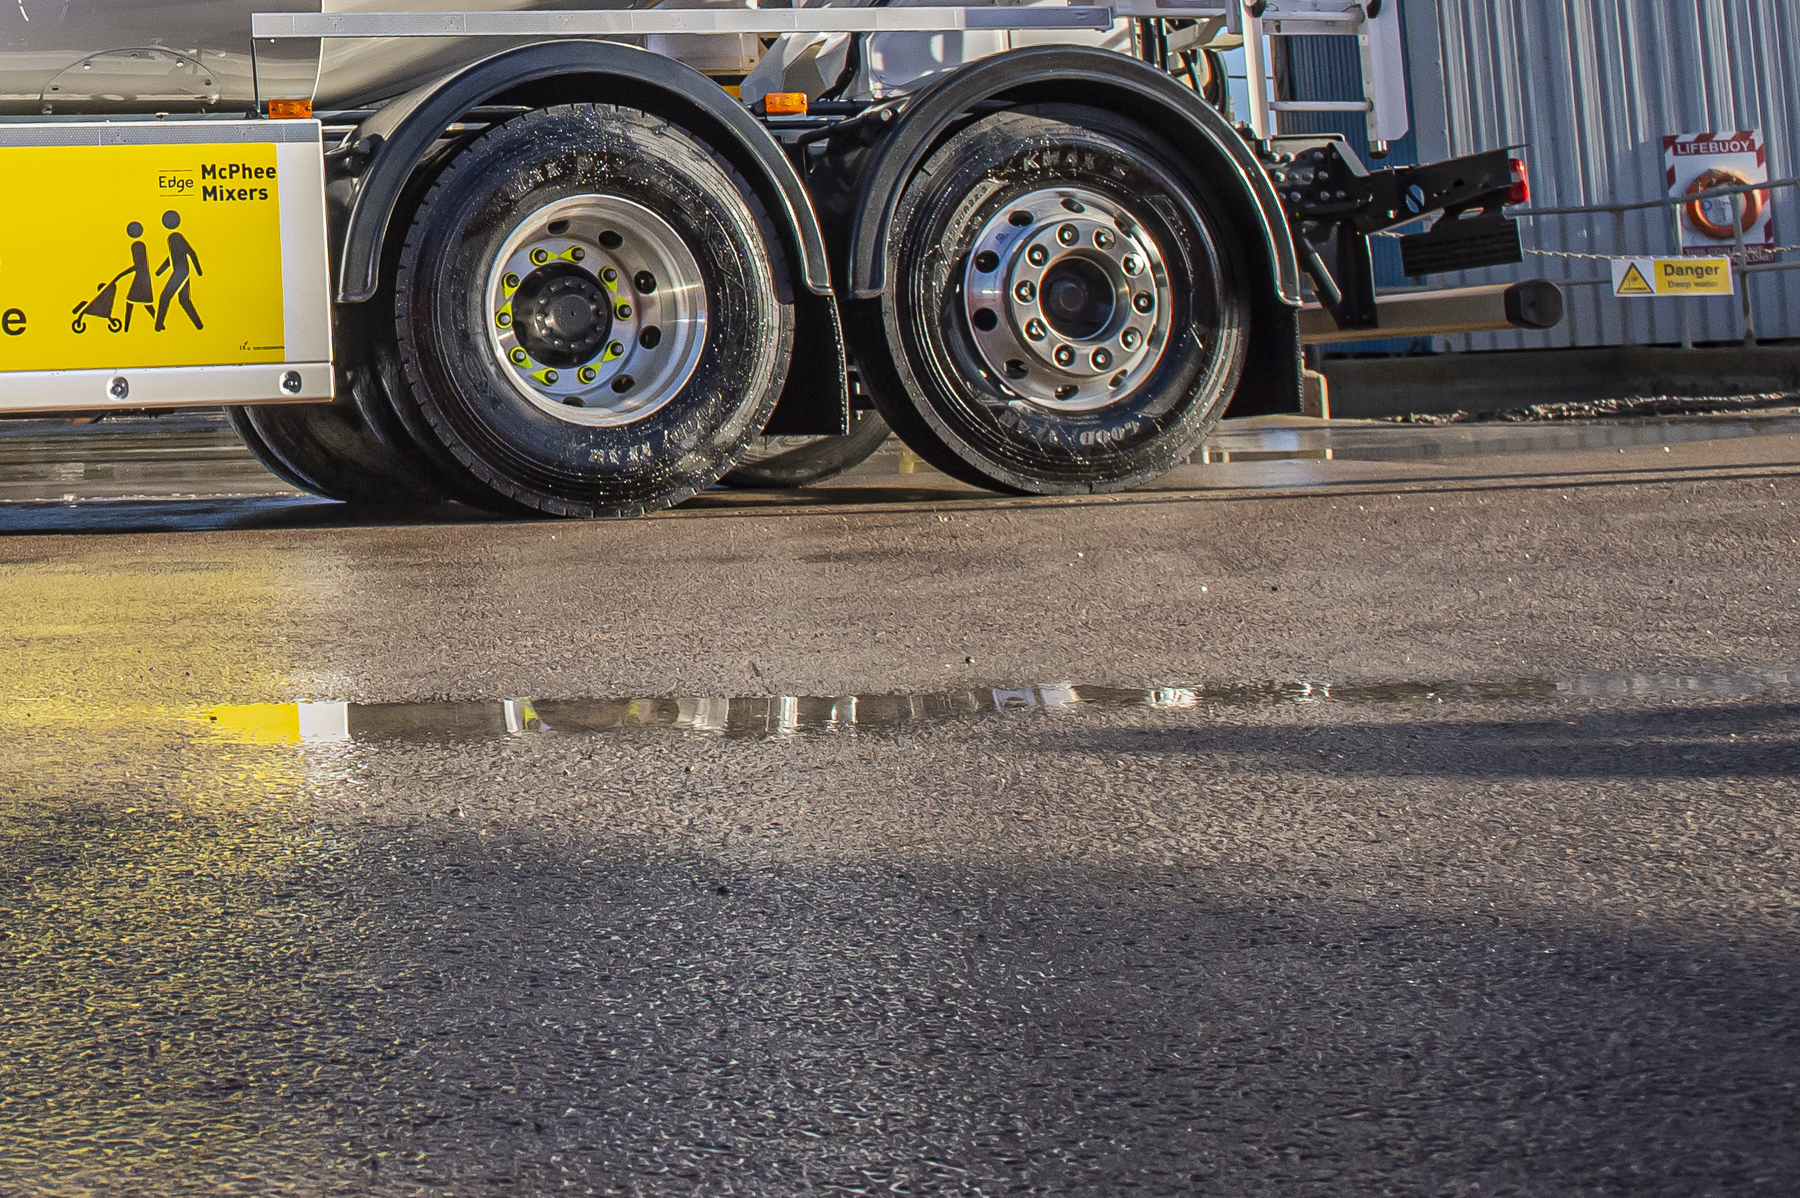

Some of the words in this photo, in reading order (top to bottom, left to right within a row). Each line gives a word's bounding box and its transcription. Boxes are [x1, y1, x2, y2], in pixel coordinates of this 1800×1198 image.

[1676, 140, 1750, 155] LIFEBUOY
[201, 163, 277, 180] McPhee
[158, 175, 194, 193] Edge
[202, 185, 269, 202] Mixers
[1664, 263, 1720, 279] Danger
[1668, 280, 1692, 289] Deep
[1694, 280, 1718, 288] water
